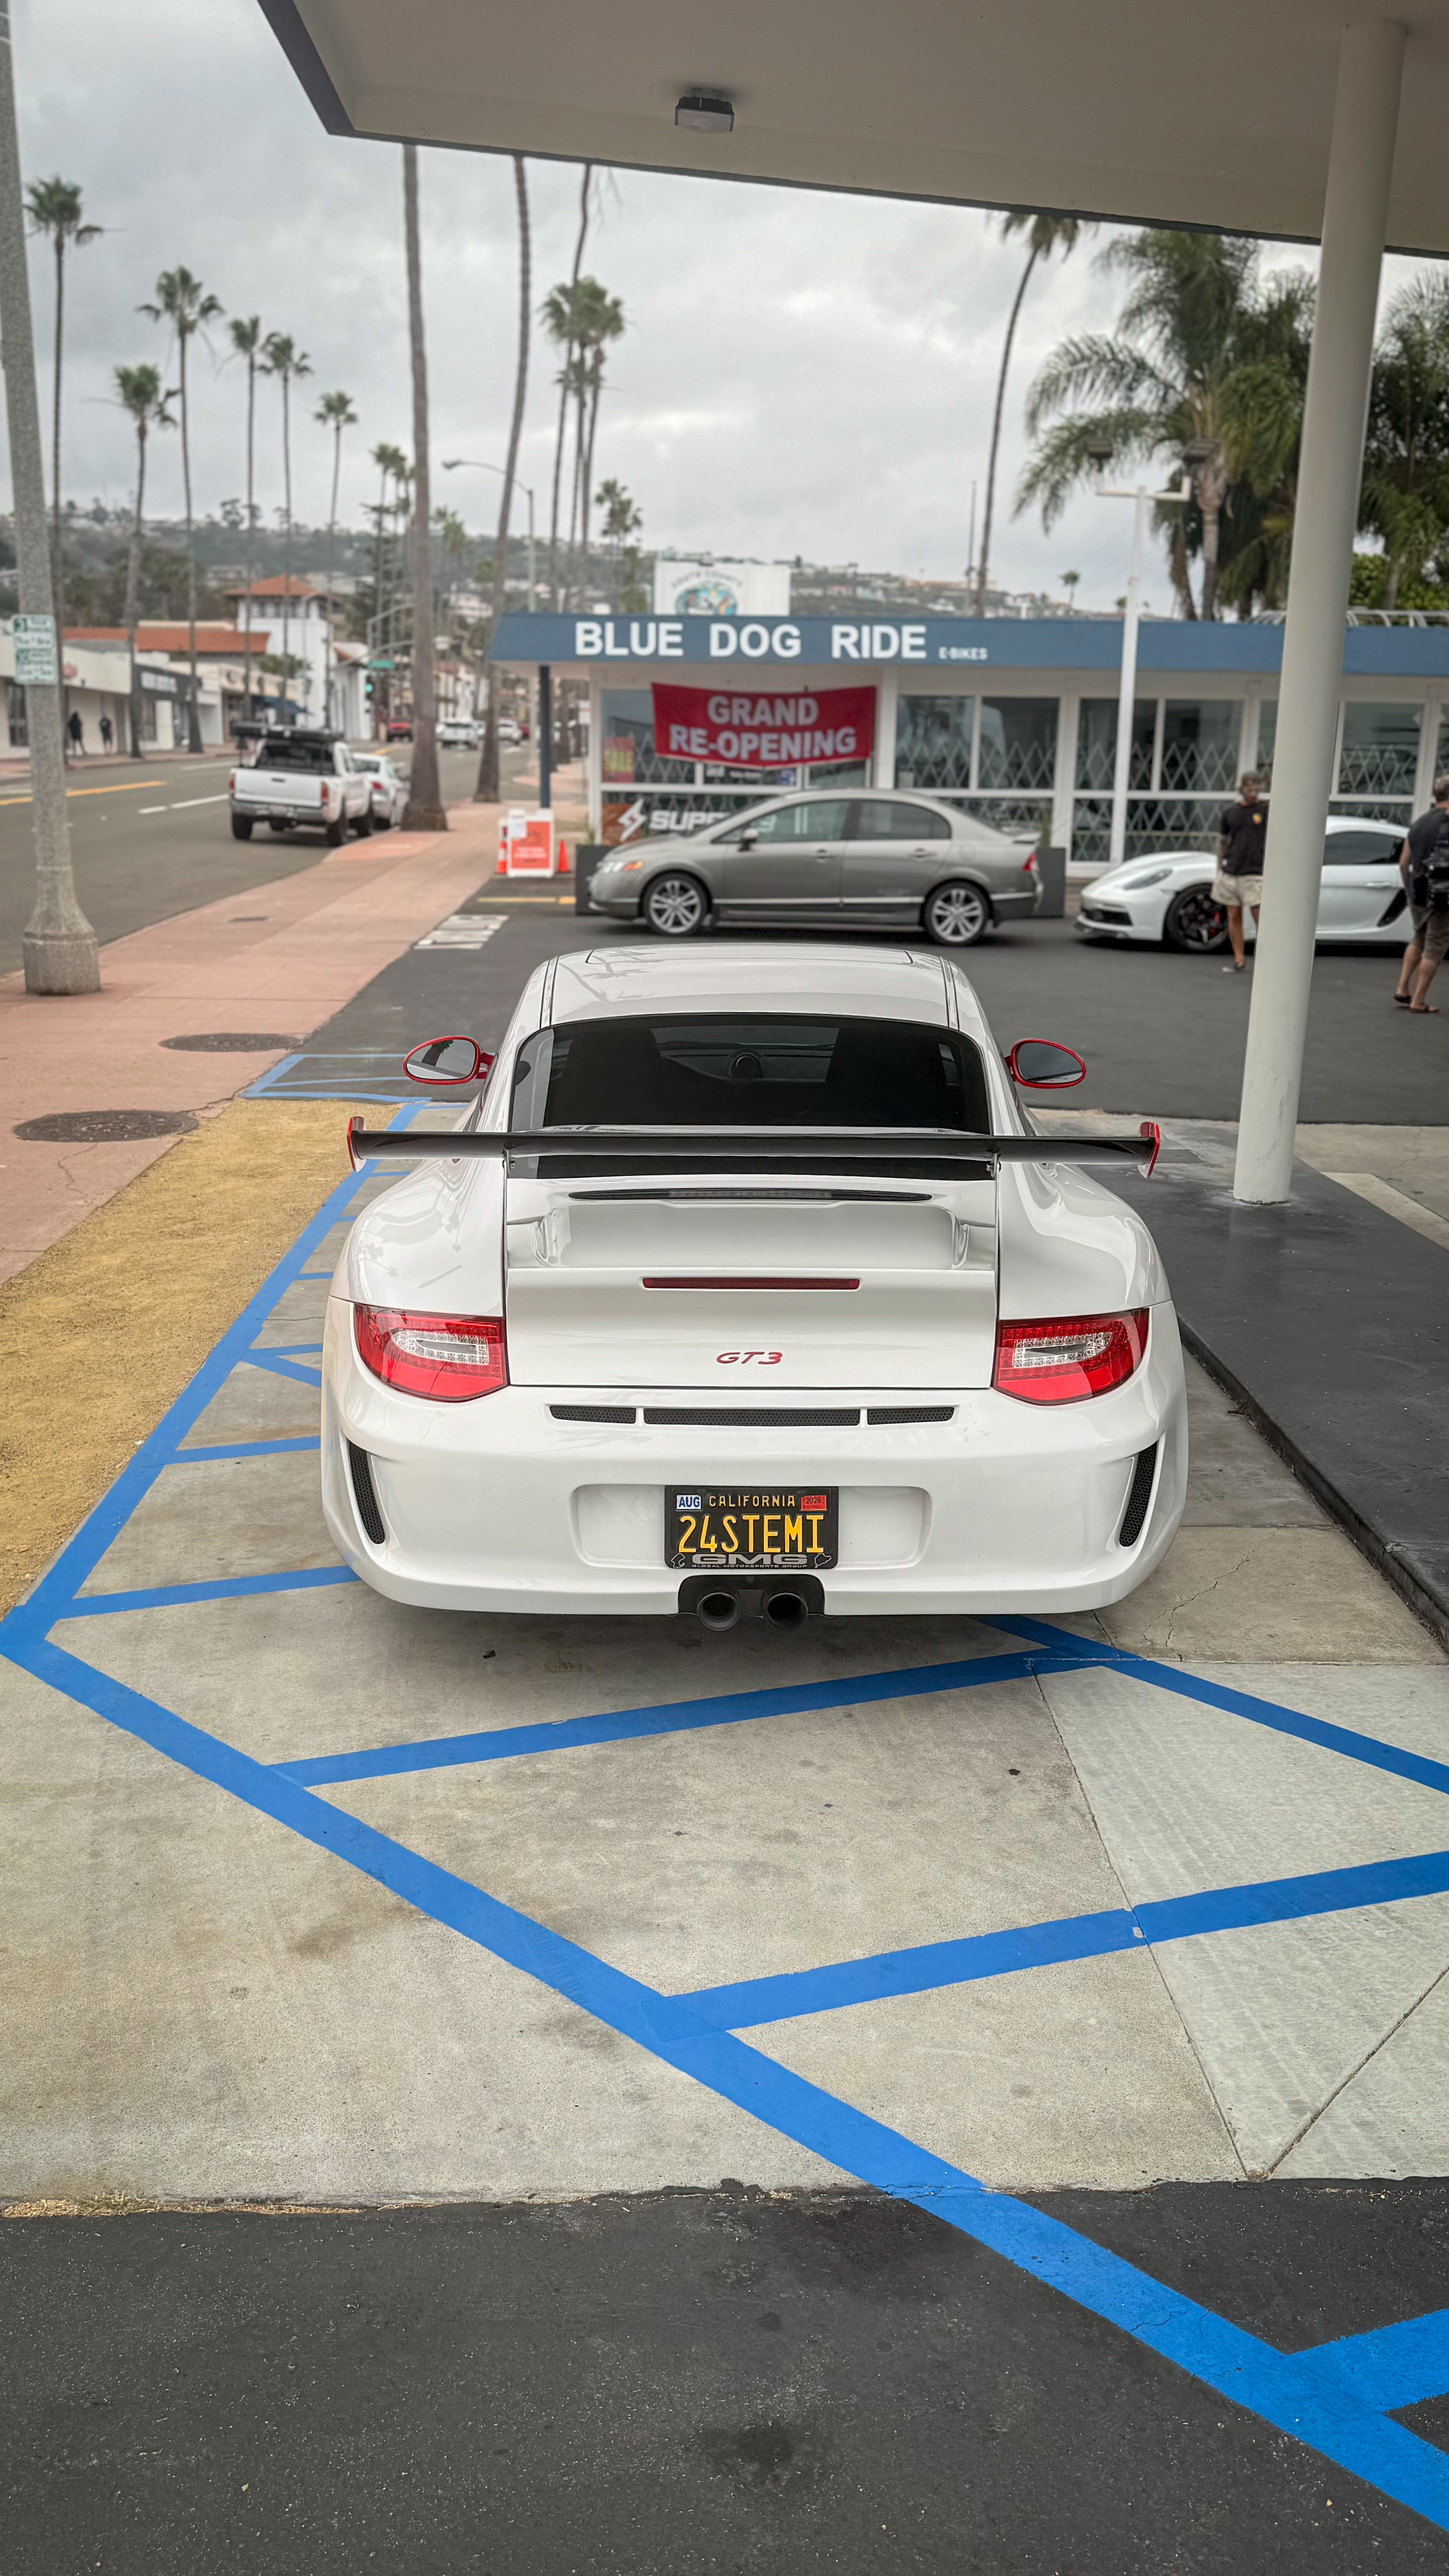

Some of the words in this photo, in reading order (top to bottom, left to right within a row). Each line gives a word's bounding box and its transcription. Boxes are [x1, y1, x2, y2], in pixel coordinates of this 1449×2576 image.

[575, 621, 684, 656] BLUE
[710, 623, 801, 658] DOG
[832, 625, 927, 659] RIDE
[707, 695, 818, 727] GRAND
[669, 724, 857, 761] RE-OPENING
[716, 1352, 782, 1365] GT3
[679, 1496, 700, 1508] AUG
[709, 1495, 795, 1507] CALIFORNIA
[679, 1515, 824, 1553] 24STEMI
[692, 1554, 807, 1565] GMG
